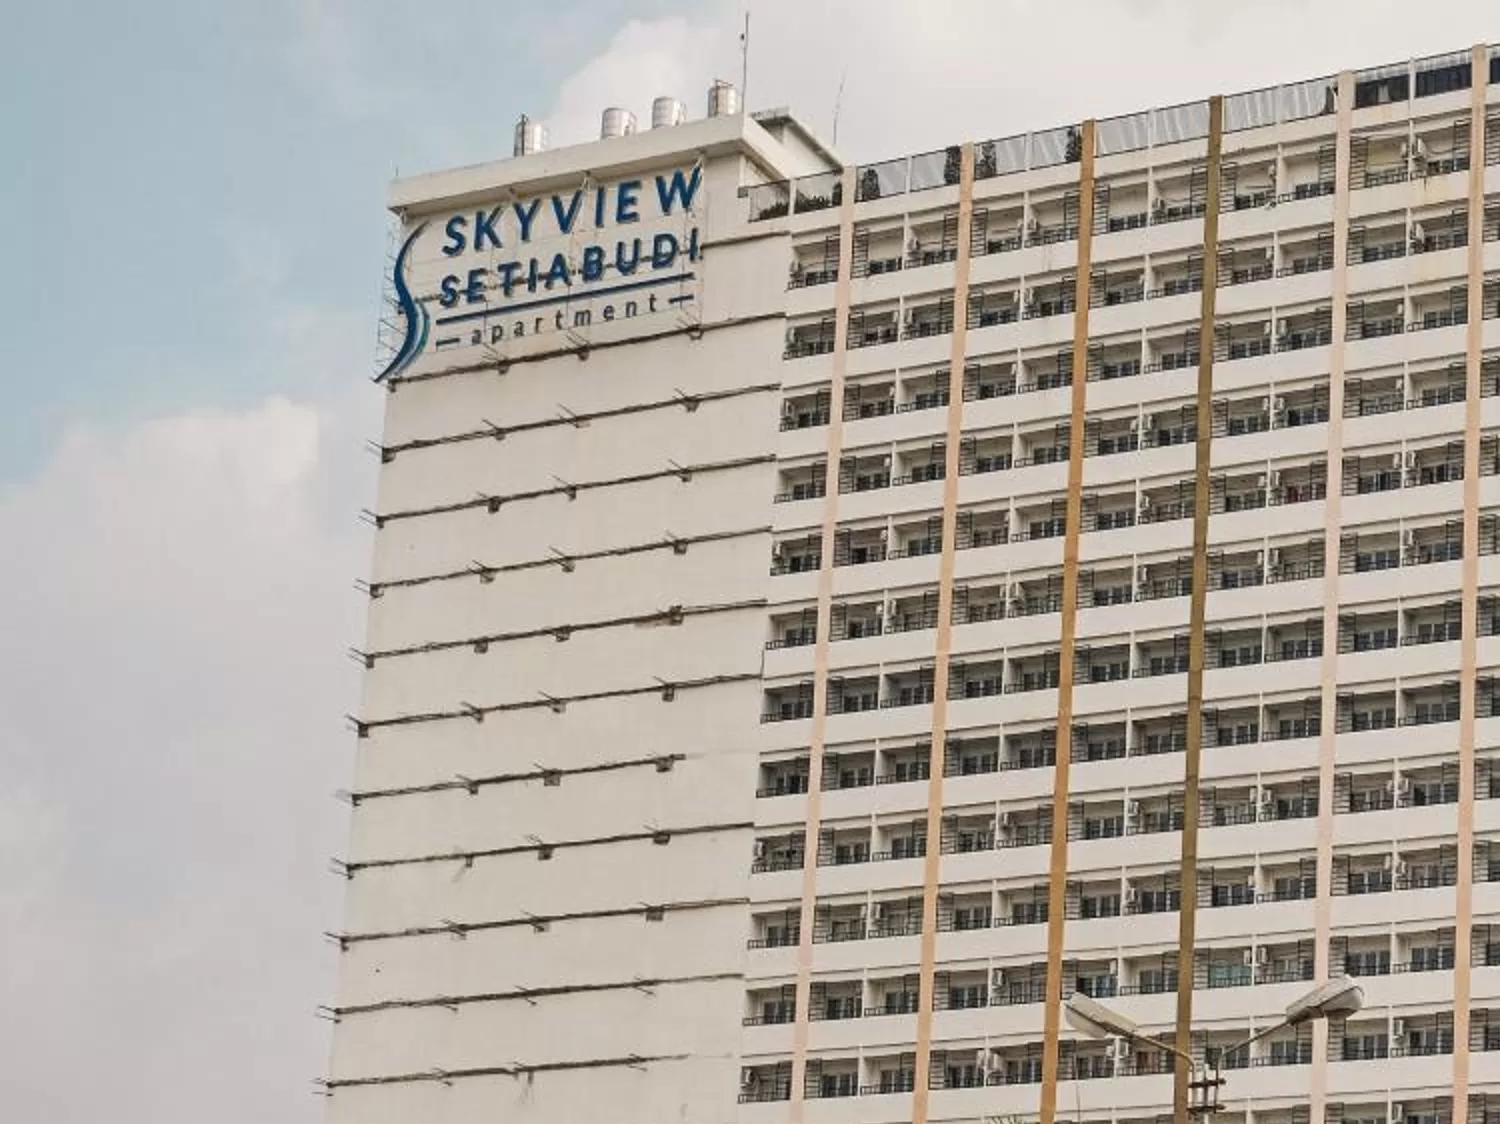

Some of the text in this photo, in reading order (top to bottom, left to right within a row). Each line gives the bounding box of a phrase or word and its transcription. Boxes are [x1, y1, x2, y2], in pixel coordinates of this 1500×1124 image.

[441, 165, 703, 257] SKYVIEW
[439, 227, 703, 309] SETIABUDI
[471, 293, 658, 346] apartment
